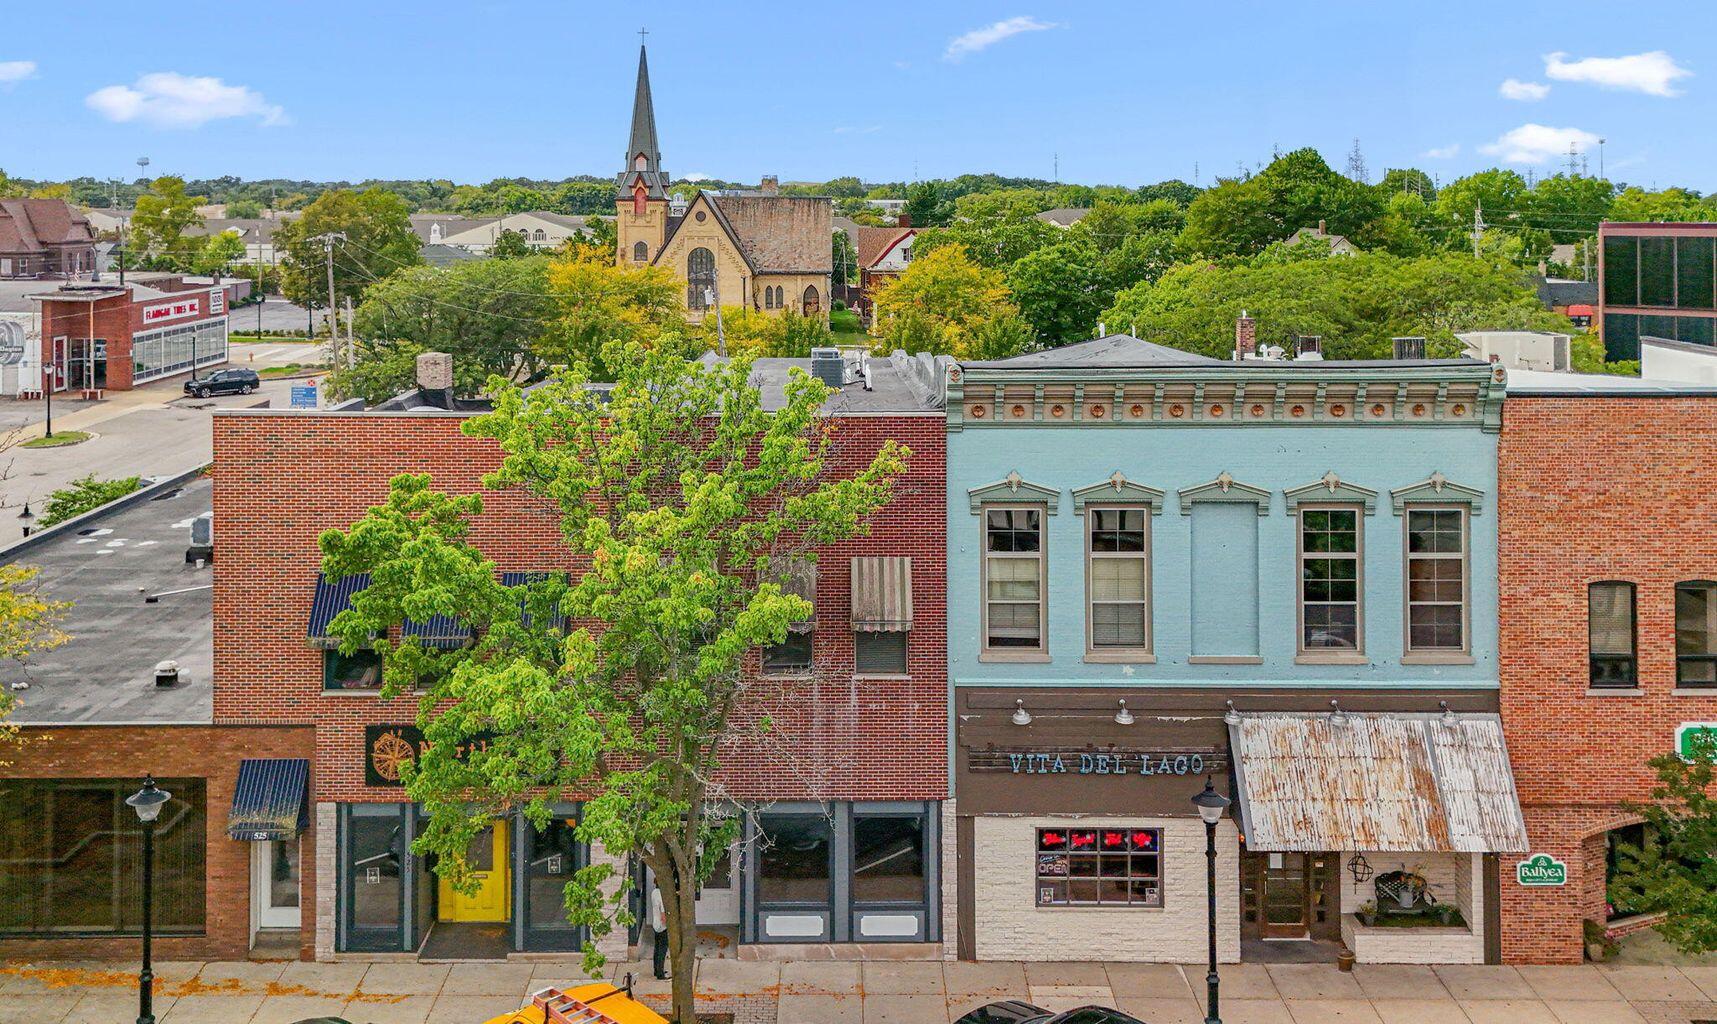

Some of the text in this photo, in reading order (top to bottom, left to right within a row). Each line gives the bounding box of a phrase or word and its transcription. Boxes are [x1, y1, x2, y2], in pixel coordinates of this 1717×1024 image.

[1009, 753, 1204, 775] VITA DEL LAGO
[253, 831, 268, 840] 525
[1039, 863, 1067, 874] OPEN
[1521, 866, 1563, 879] Ballyea
